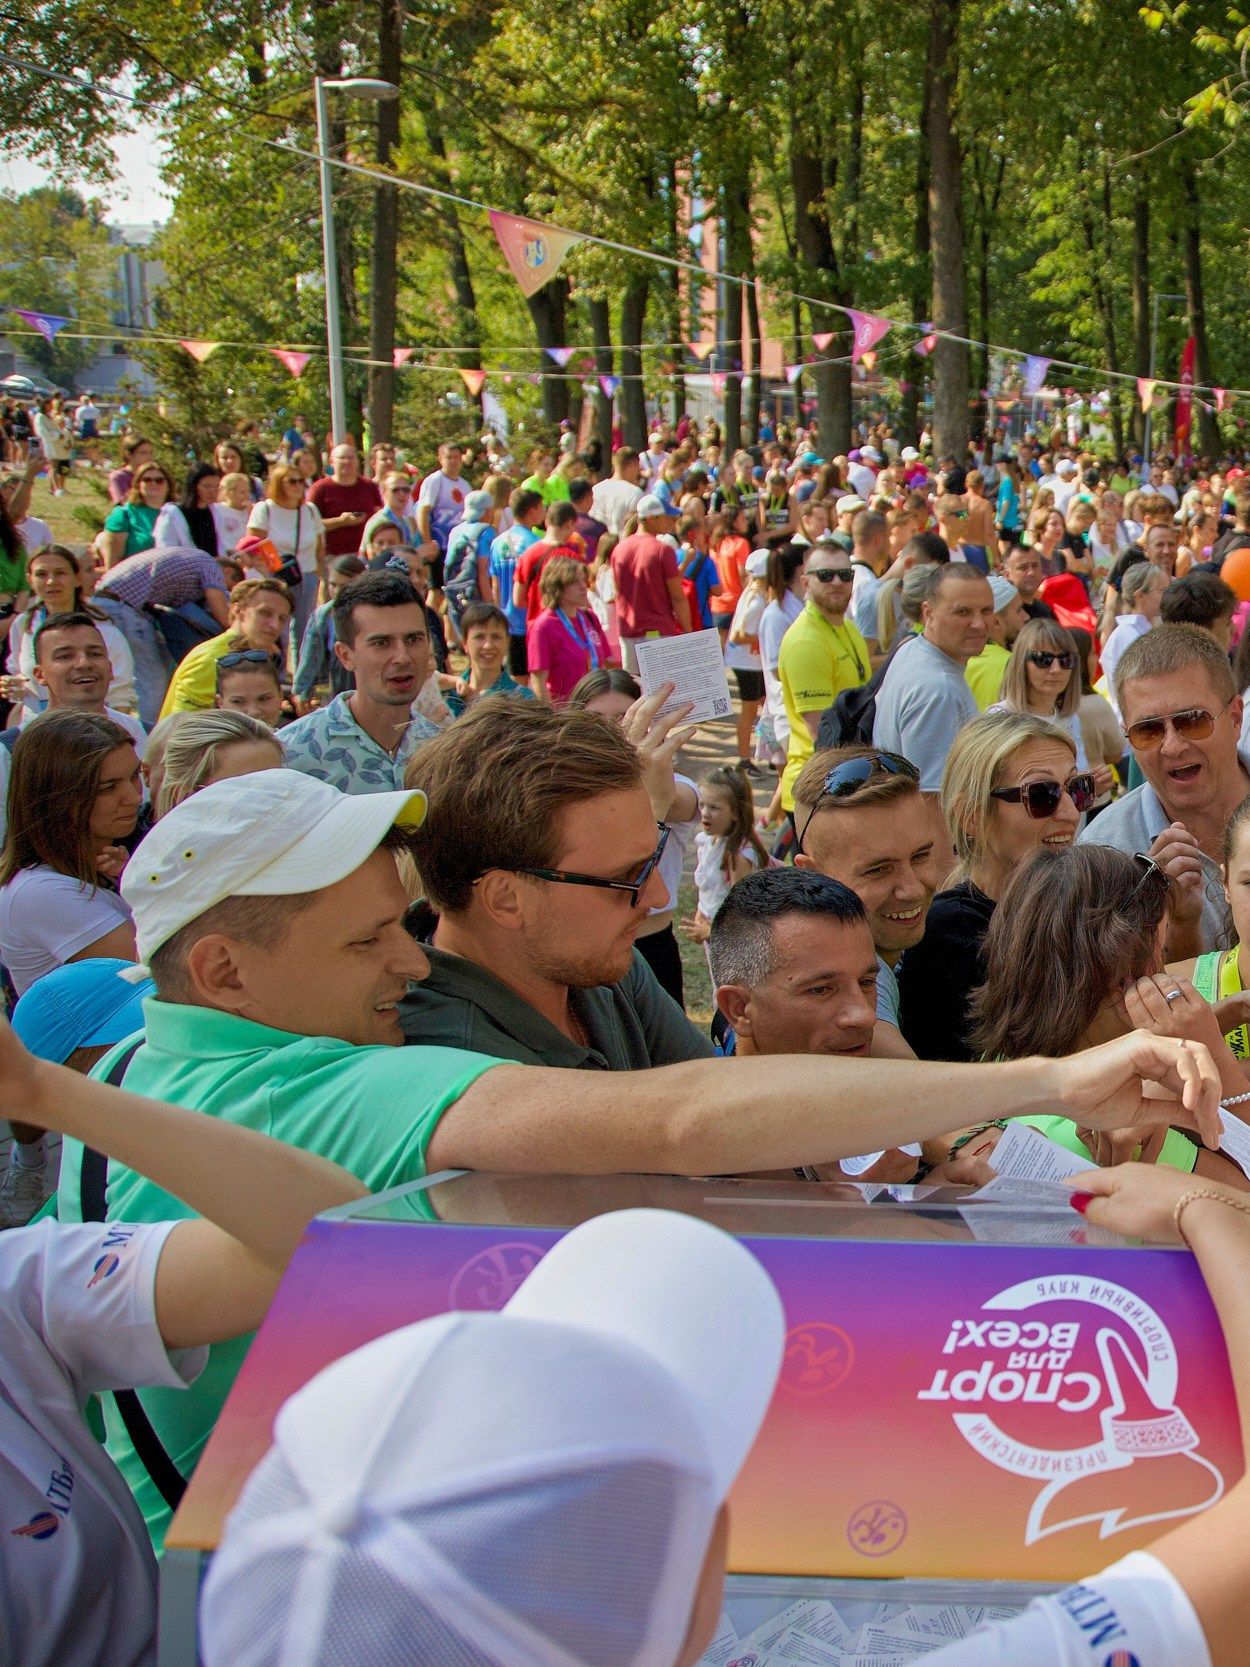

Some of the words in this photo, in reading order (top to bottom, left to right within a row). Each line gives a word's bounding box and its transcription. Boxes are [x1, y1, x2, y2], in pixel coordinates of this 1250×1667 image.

[1037, 1280, 1080, 1297] КЛУБ
[1007, 1350, 1073, 1370] для
[917, 1361, 1102, 1412] Спорт
